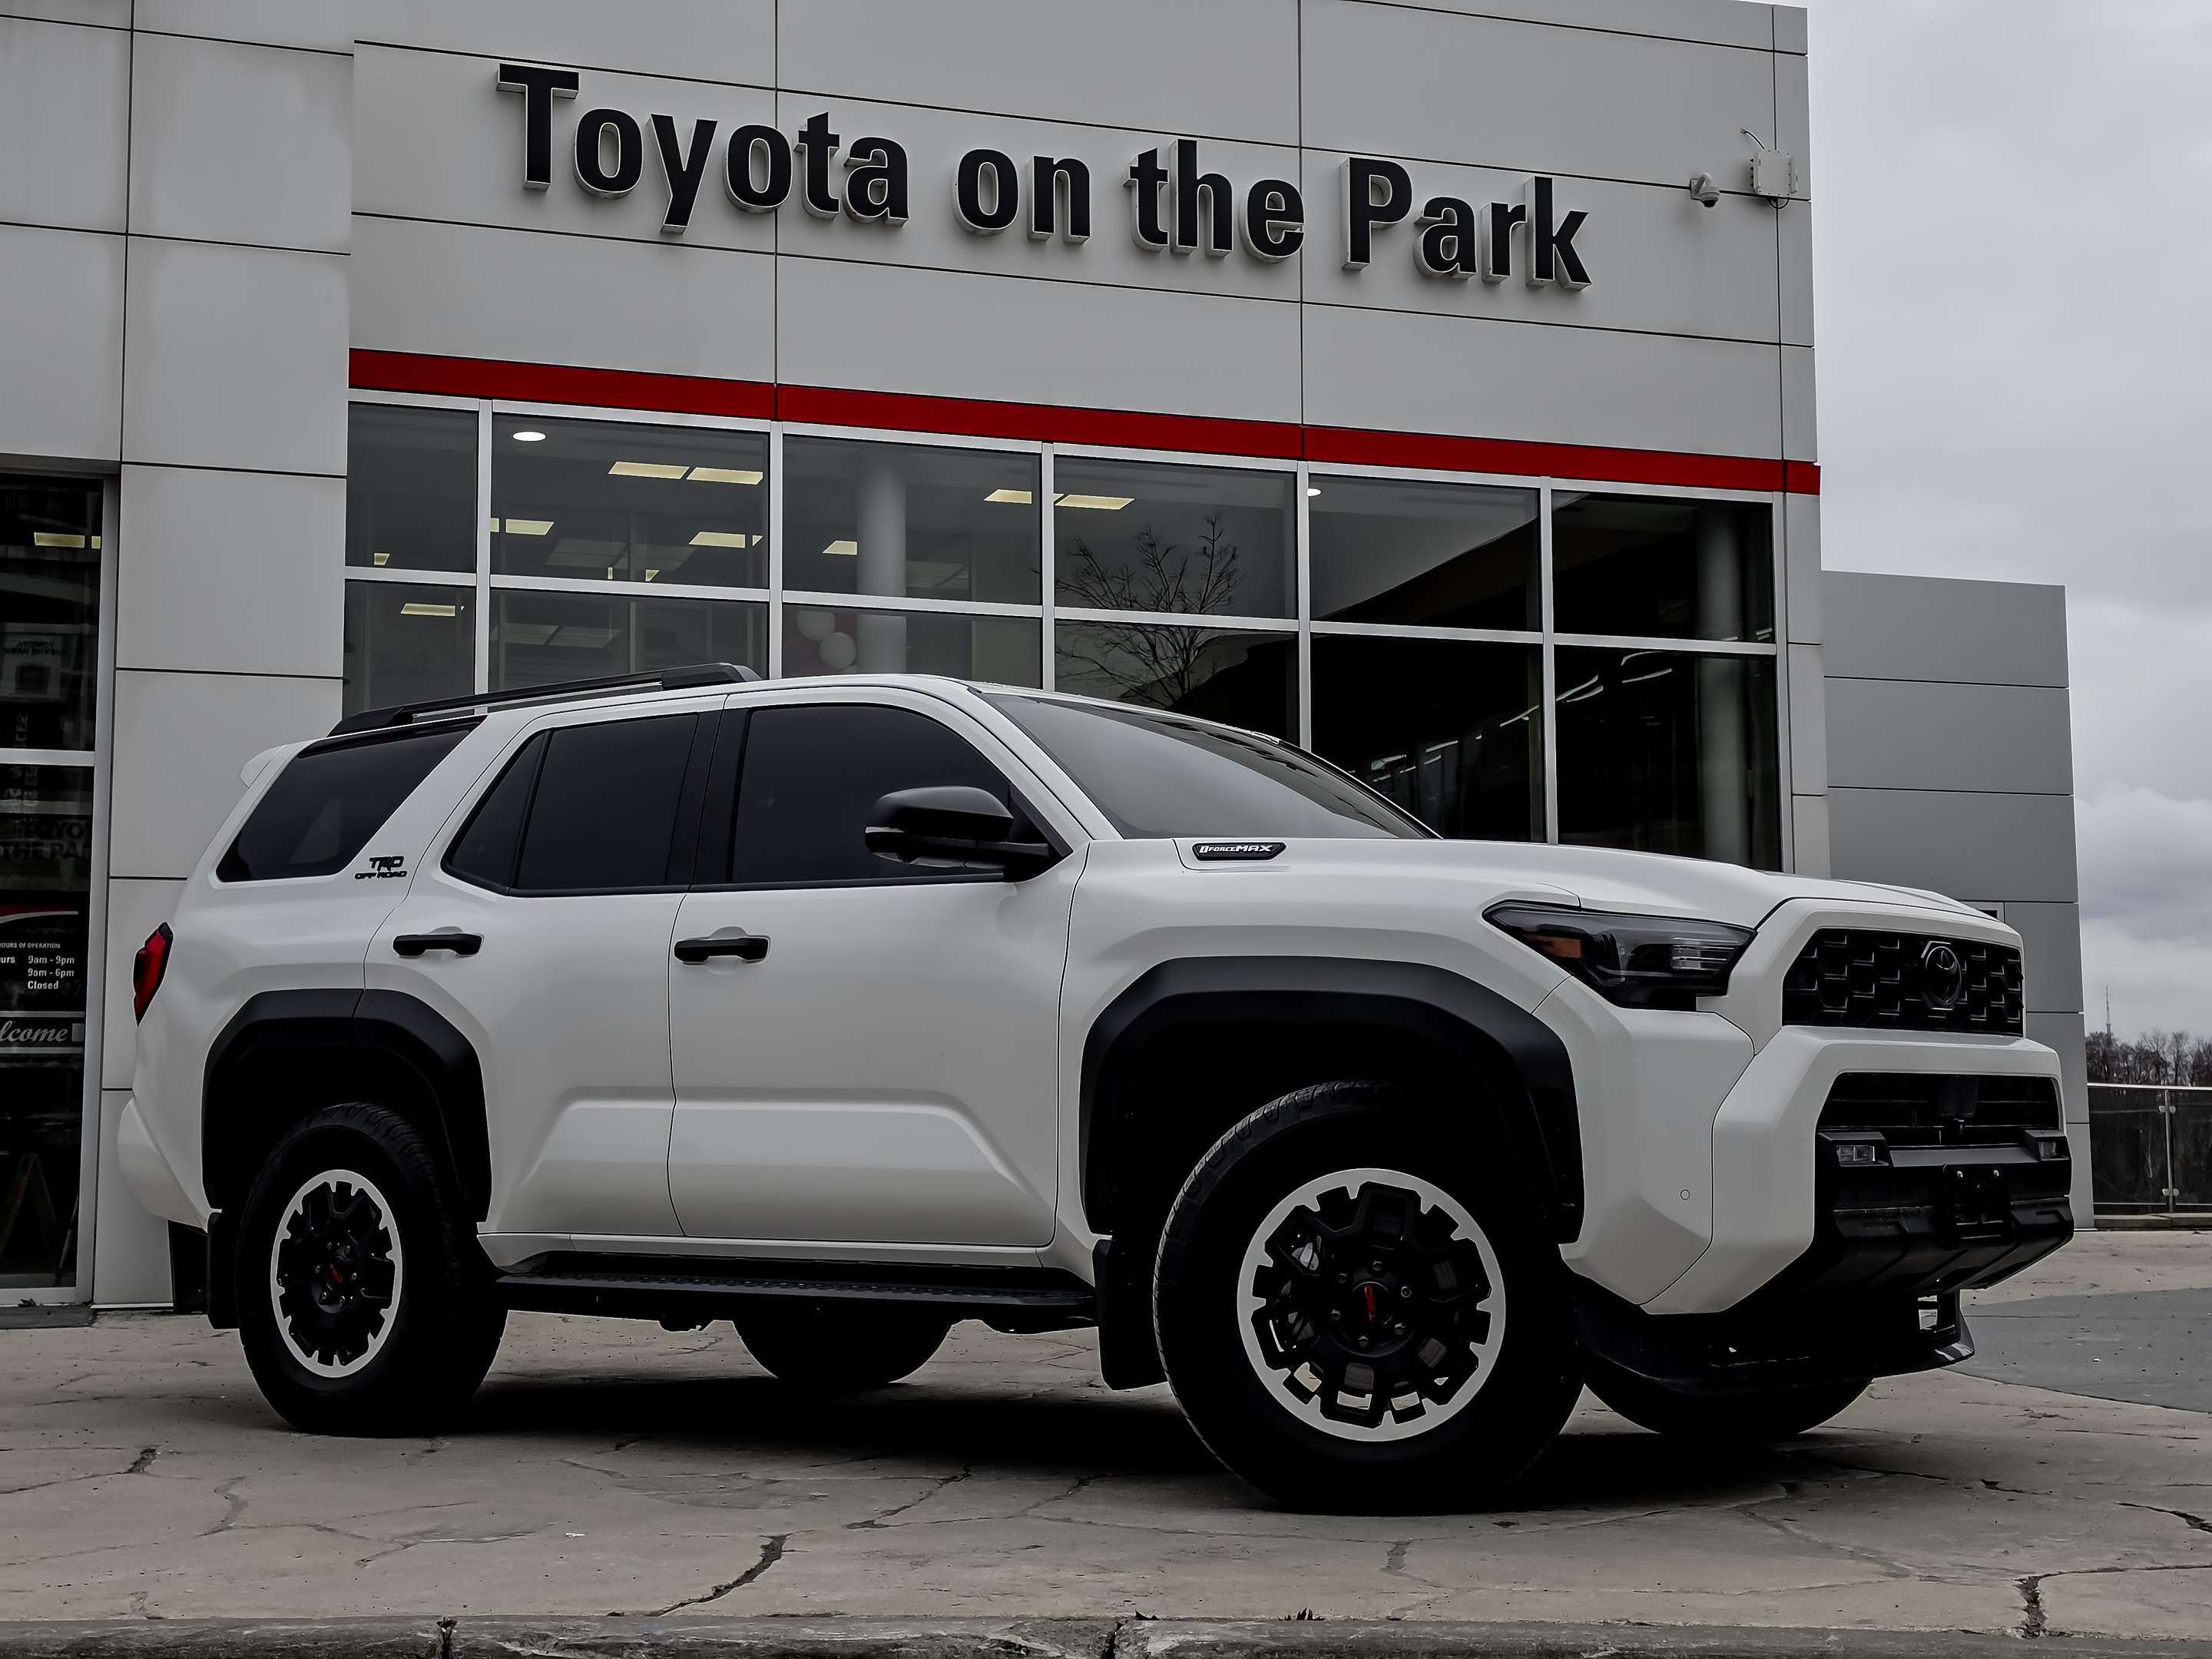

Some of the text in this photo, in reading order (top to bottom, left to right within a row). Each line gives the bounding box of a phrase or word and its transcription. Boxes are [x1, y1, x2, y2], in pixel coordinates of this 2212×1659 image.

[496, 62, 1592, 290] Toyota on the Park
[369, 856, 404, 871] TRD
[28, 955, 48, 964] 9am
[55, 955, 75, 966] 9pm
[28, 968, 47, 977] 9am
[55, 968, 75, 979] 6pm
[27, 980, 59, 989] Closed
[0, 1020, 68, 1042] lcome
